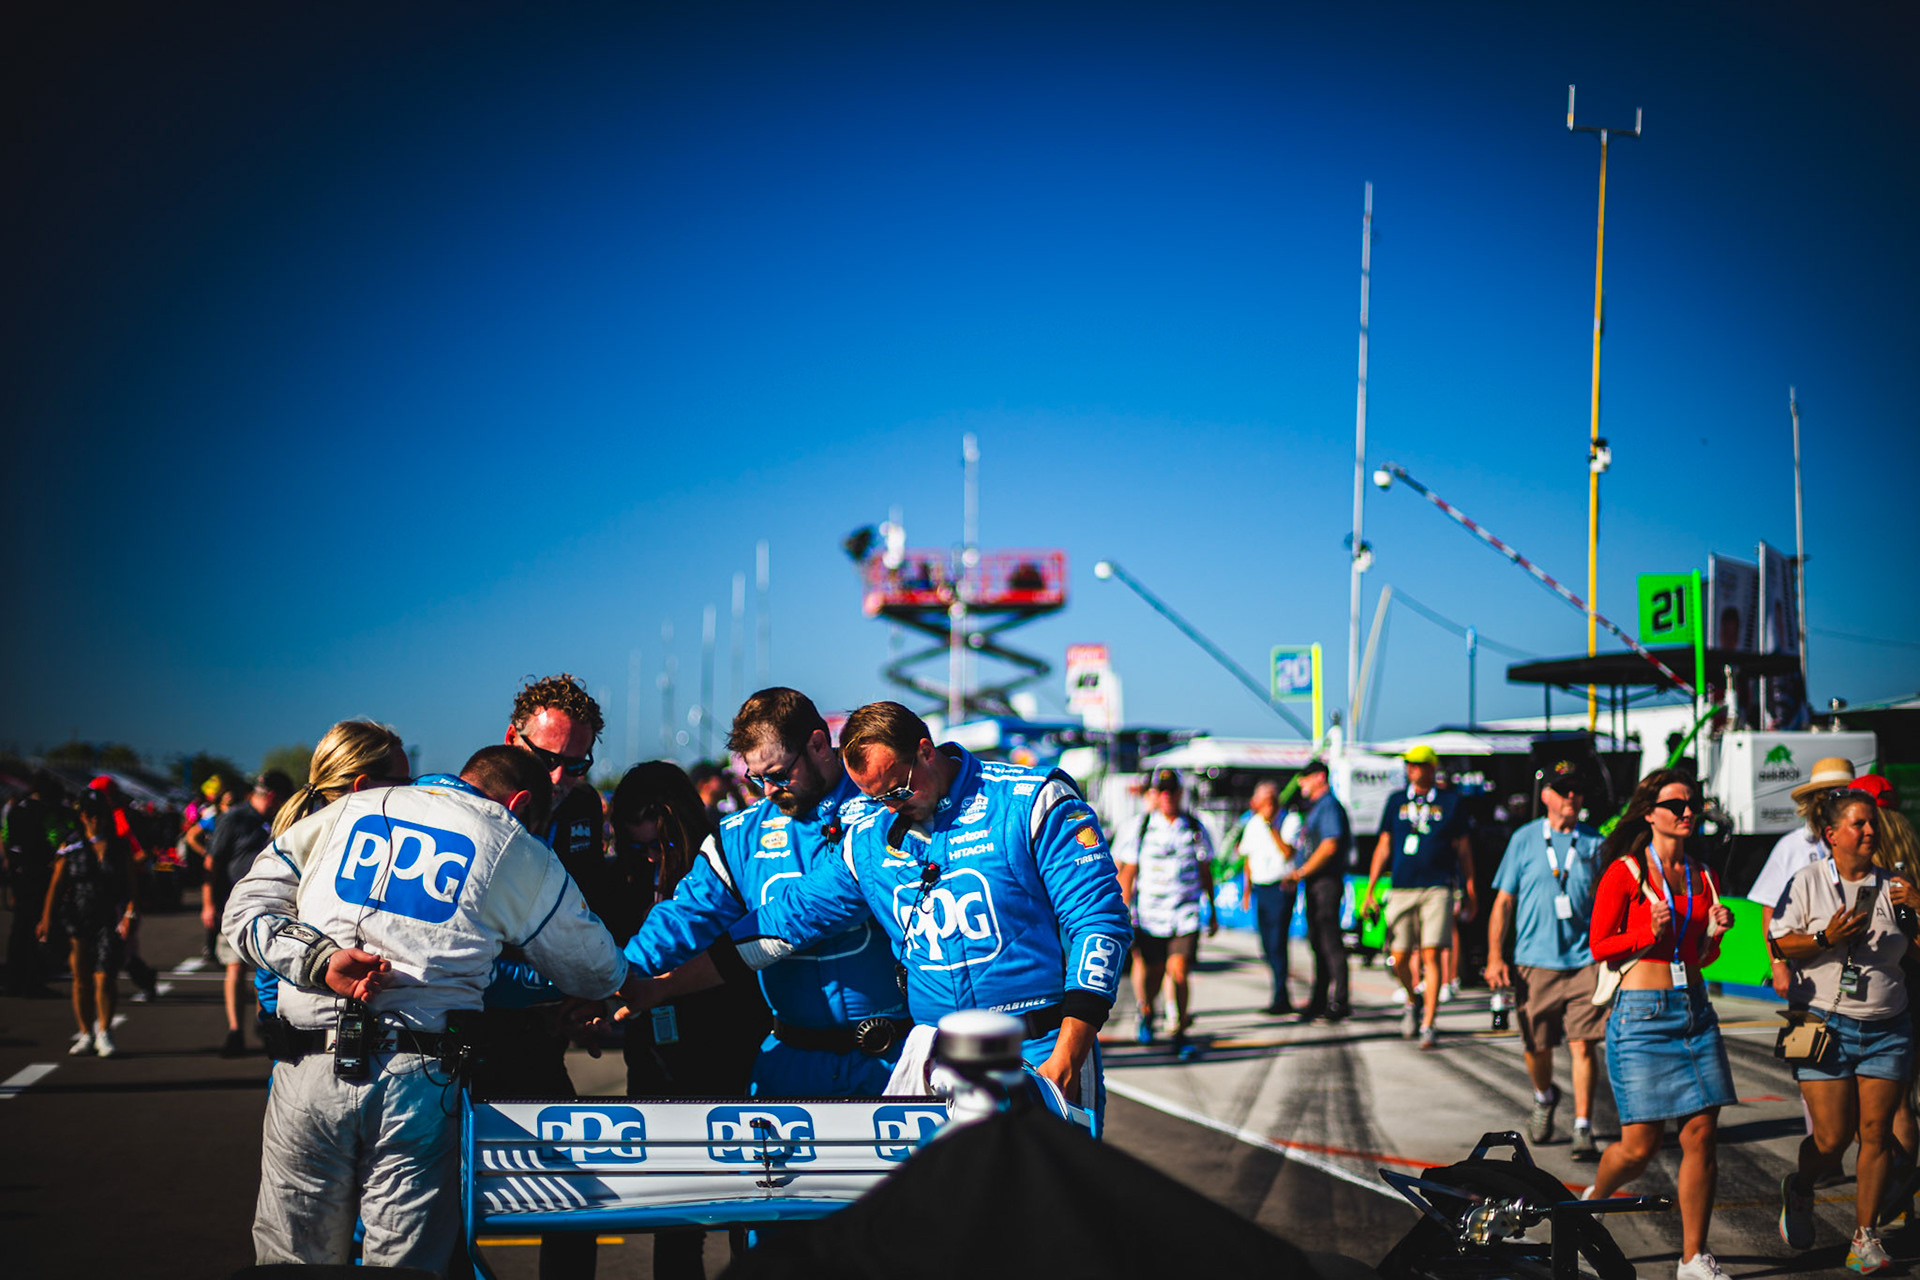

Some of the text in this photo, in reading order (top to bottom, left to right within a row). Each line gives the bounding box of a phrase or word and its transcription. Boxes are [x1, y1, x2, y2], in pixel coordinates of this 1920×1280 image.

[1652, 586, 1686, 632] 21
[1278, 656, 1312, 692] 20
[949, 829, 988, 845] verizon
[949, 842, 994, 860] HITACHI
[1074, 854, 1094, 866] TIRE
[341, 825, 468, 903] PPG
[901, 889, 991, 960] PPG
[1084, 938, 1115, 988] PPG
[988, 998, 1047, 1013] CRABTREE
[541, 1111, 642, 1161] PPG
[711, 1111, 813, 1161] PPG
[877, 1111, 946, 1157] PP
